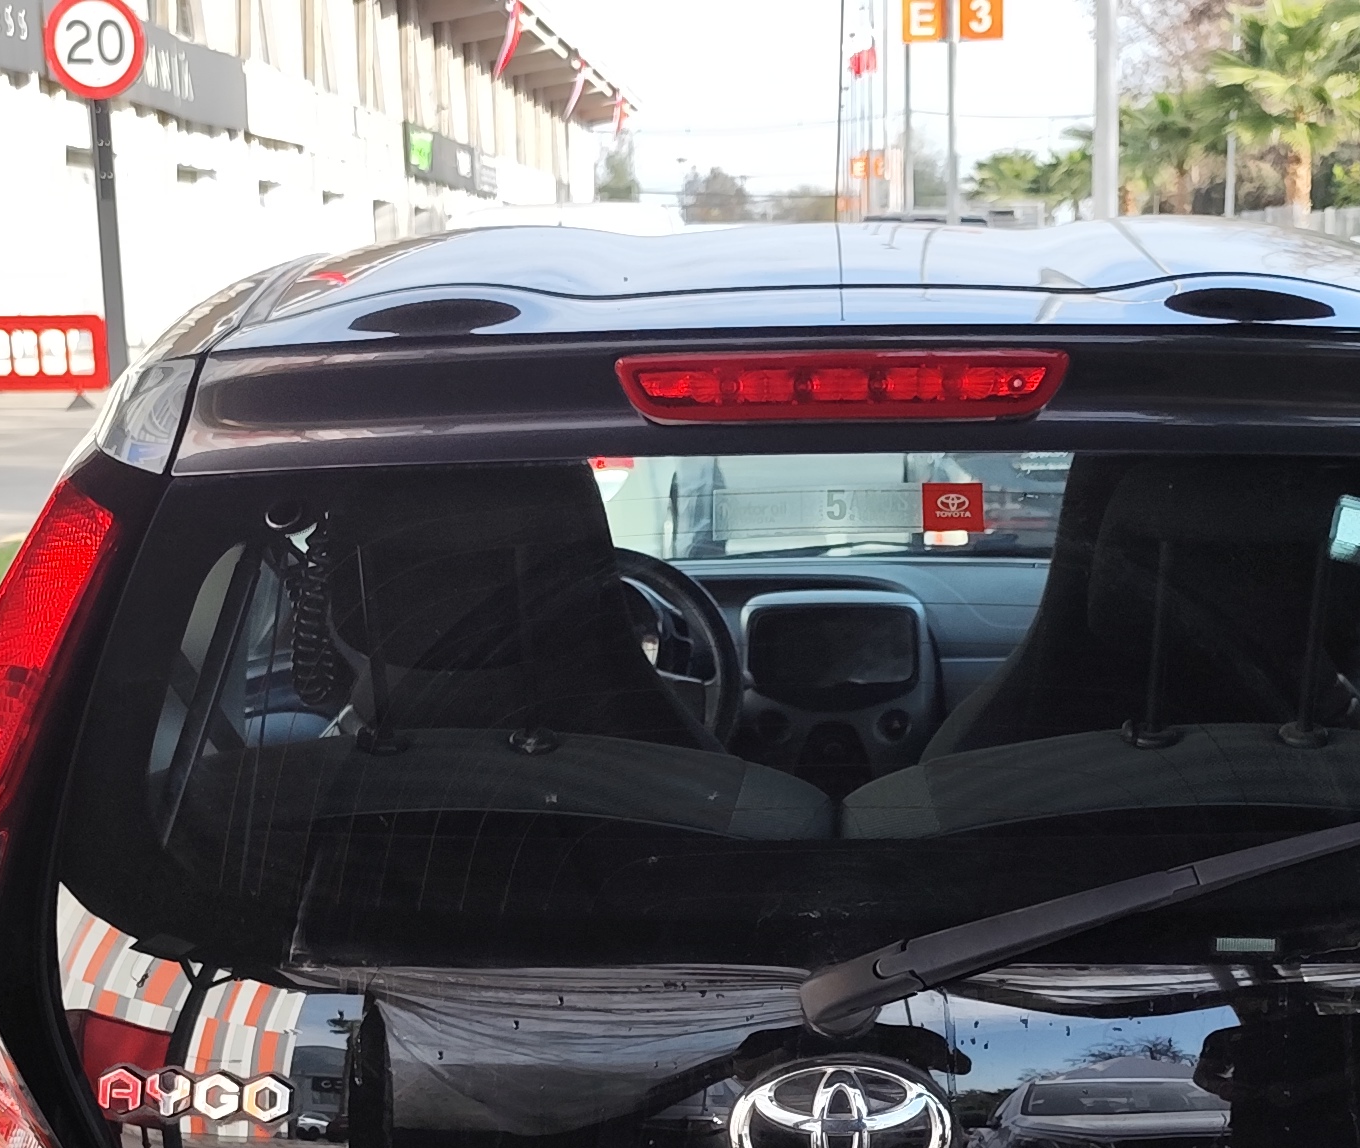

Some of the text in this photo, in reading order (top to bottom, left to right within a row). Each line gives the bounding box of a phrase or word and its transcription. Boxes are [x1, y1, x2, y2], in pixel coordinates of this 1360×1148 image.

[909, 0, 992, 36] E 3
[66, 19, 125, 65] 20
[826, 489, 847, 520] 5
[97, 1067, 291, 1122] AYGO
